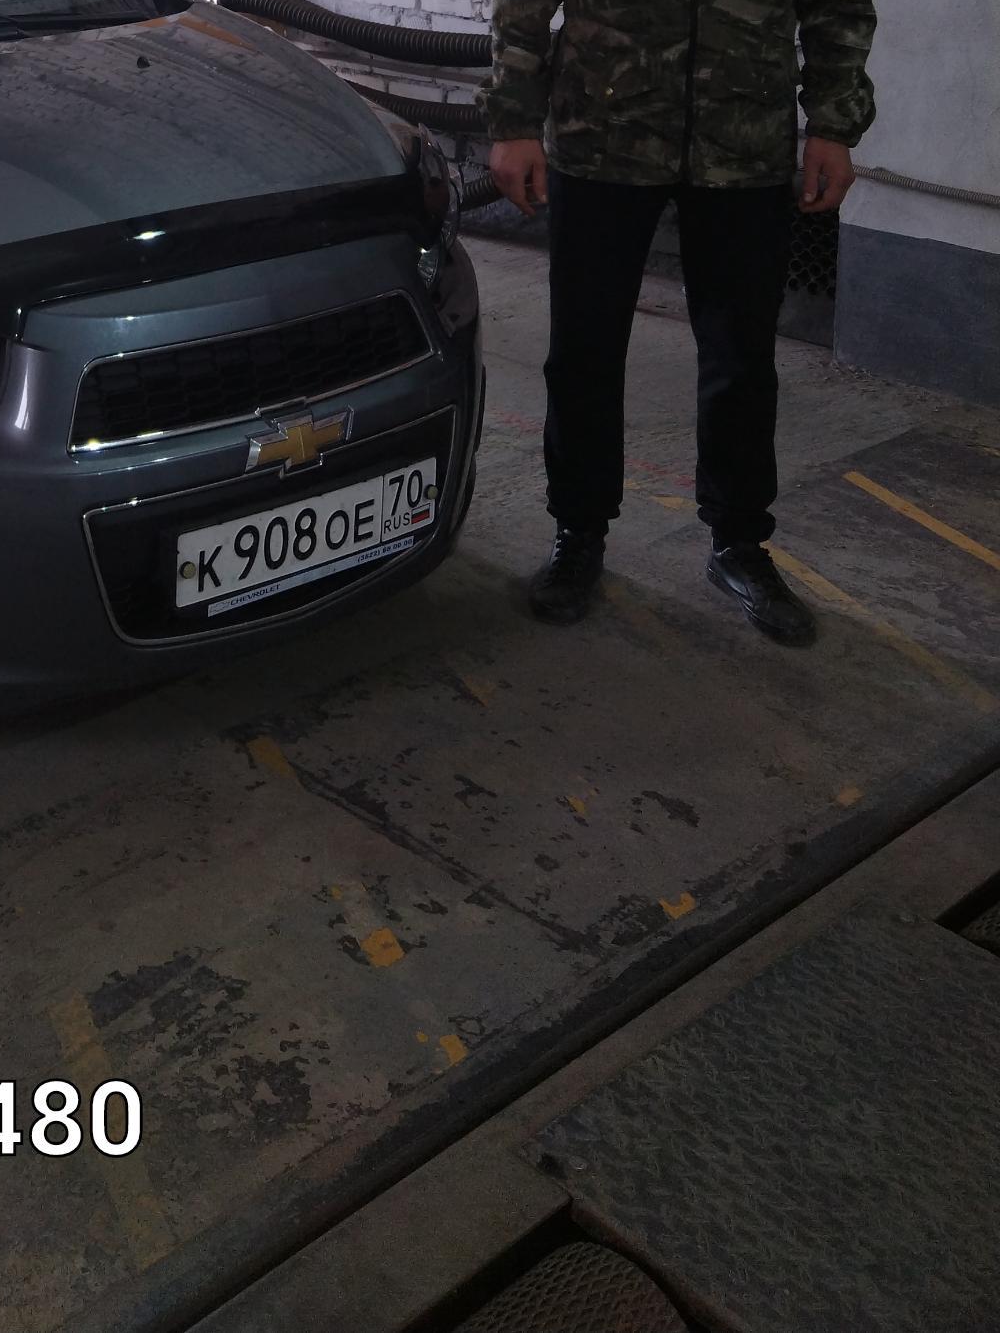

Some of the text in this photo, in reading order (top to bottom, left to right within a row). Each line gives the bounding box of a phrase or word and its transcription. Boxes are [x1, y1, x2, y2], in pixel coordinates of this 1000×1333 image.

[388, 469, 423, 516] 70
[383, 512, 411, 534] RUS
[229, 583, 281, 606] CHEVROLET
